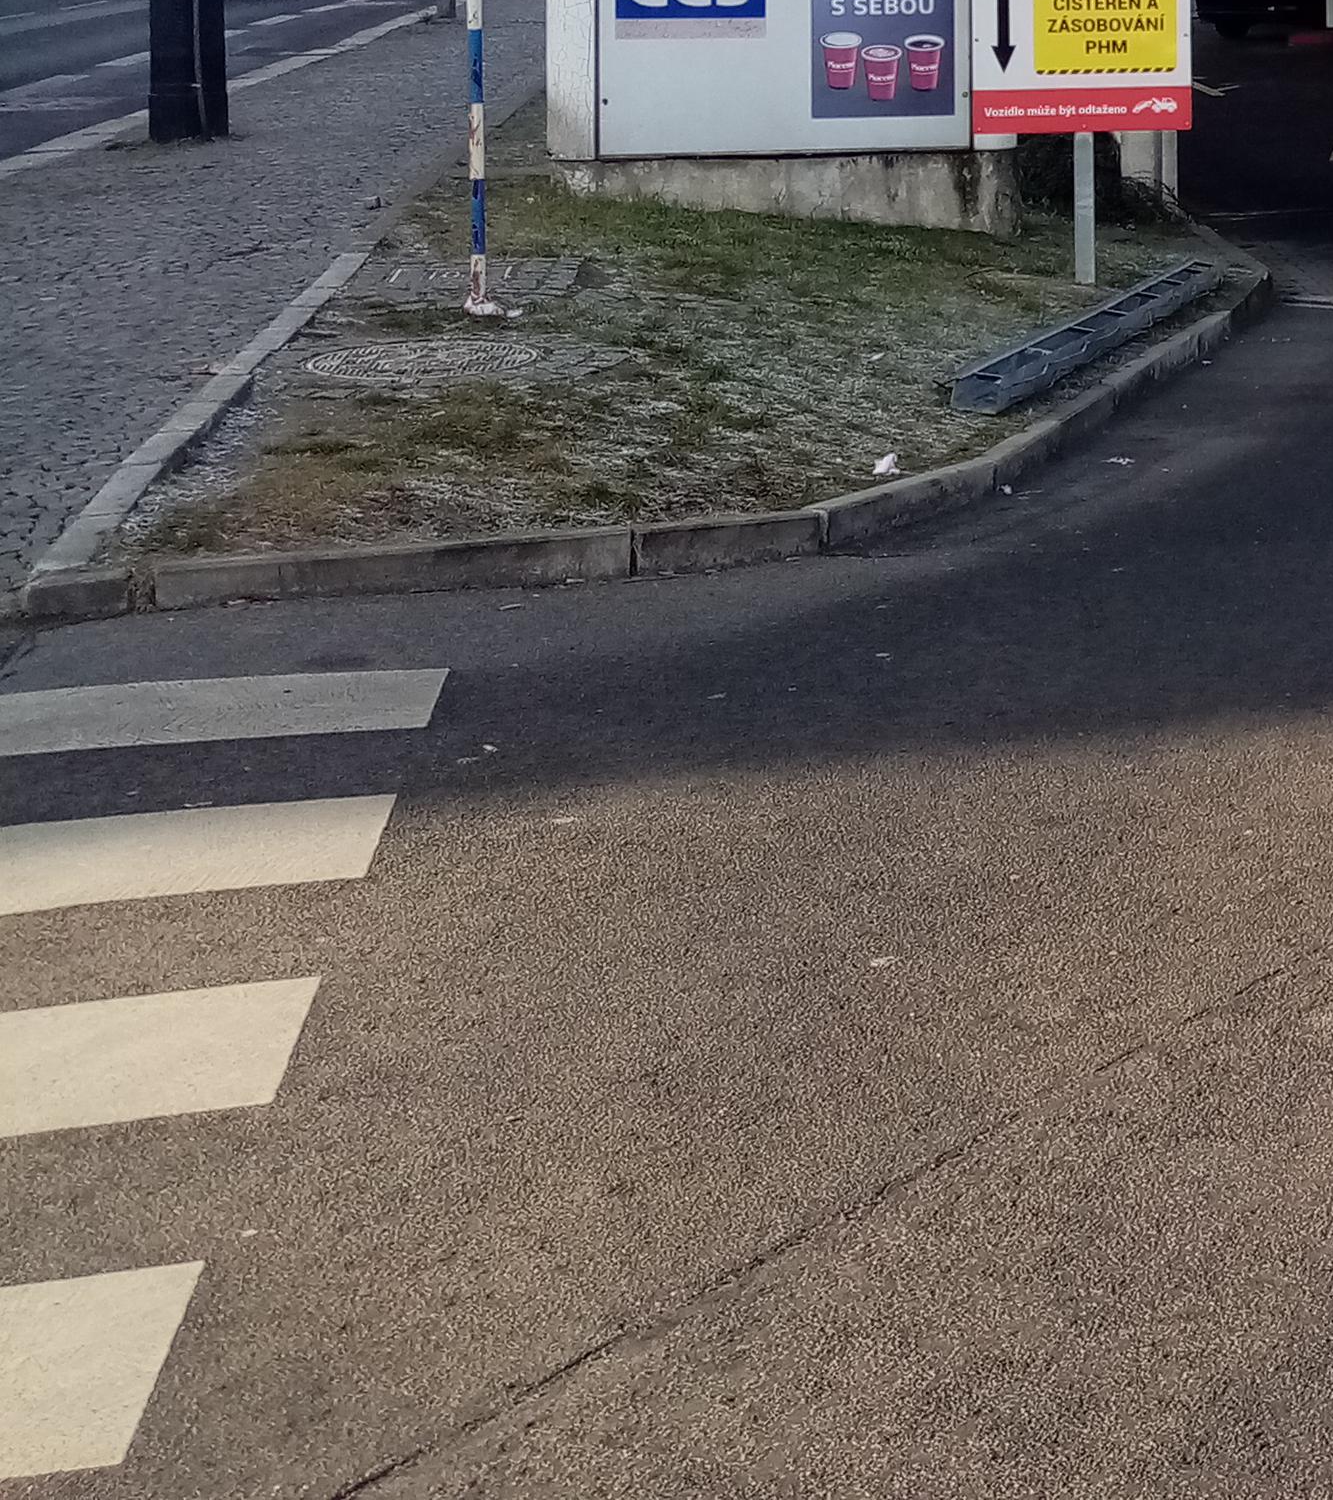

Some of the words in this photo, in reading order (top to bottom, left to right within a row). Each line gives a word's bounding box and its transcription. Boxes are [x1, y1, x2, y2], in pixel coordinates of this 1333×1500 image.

[1047, 13, 1165, 33] ZÁSOBOVÁNÍ
[1085, 40, 1128, 54] PHM
[984, 107, 1025, 117] Vozidlo
[1027, 105, 1056, 116] může
[1059, 104, 1076, 118] být
[1079, 104, 1127, 115] odtaženo
